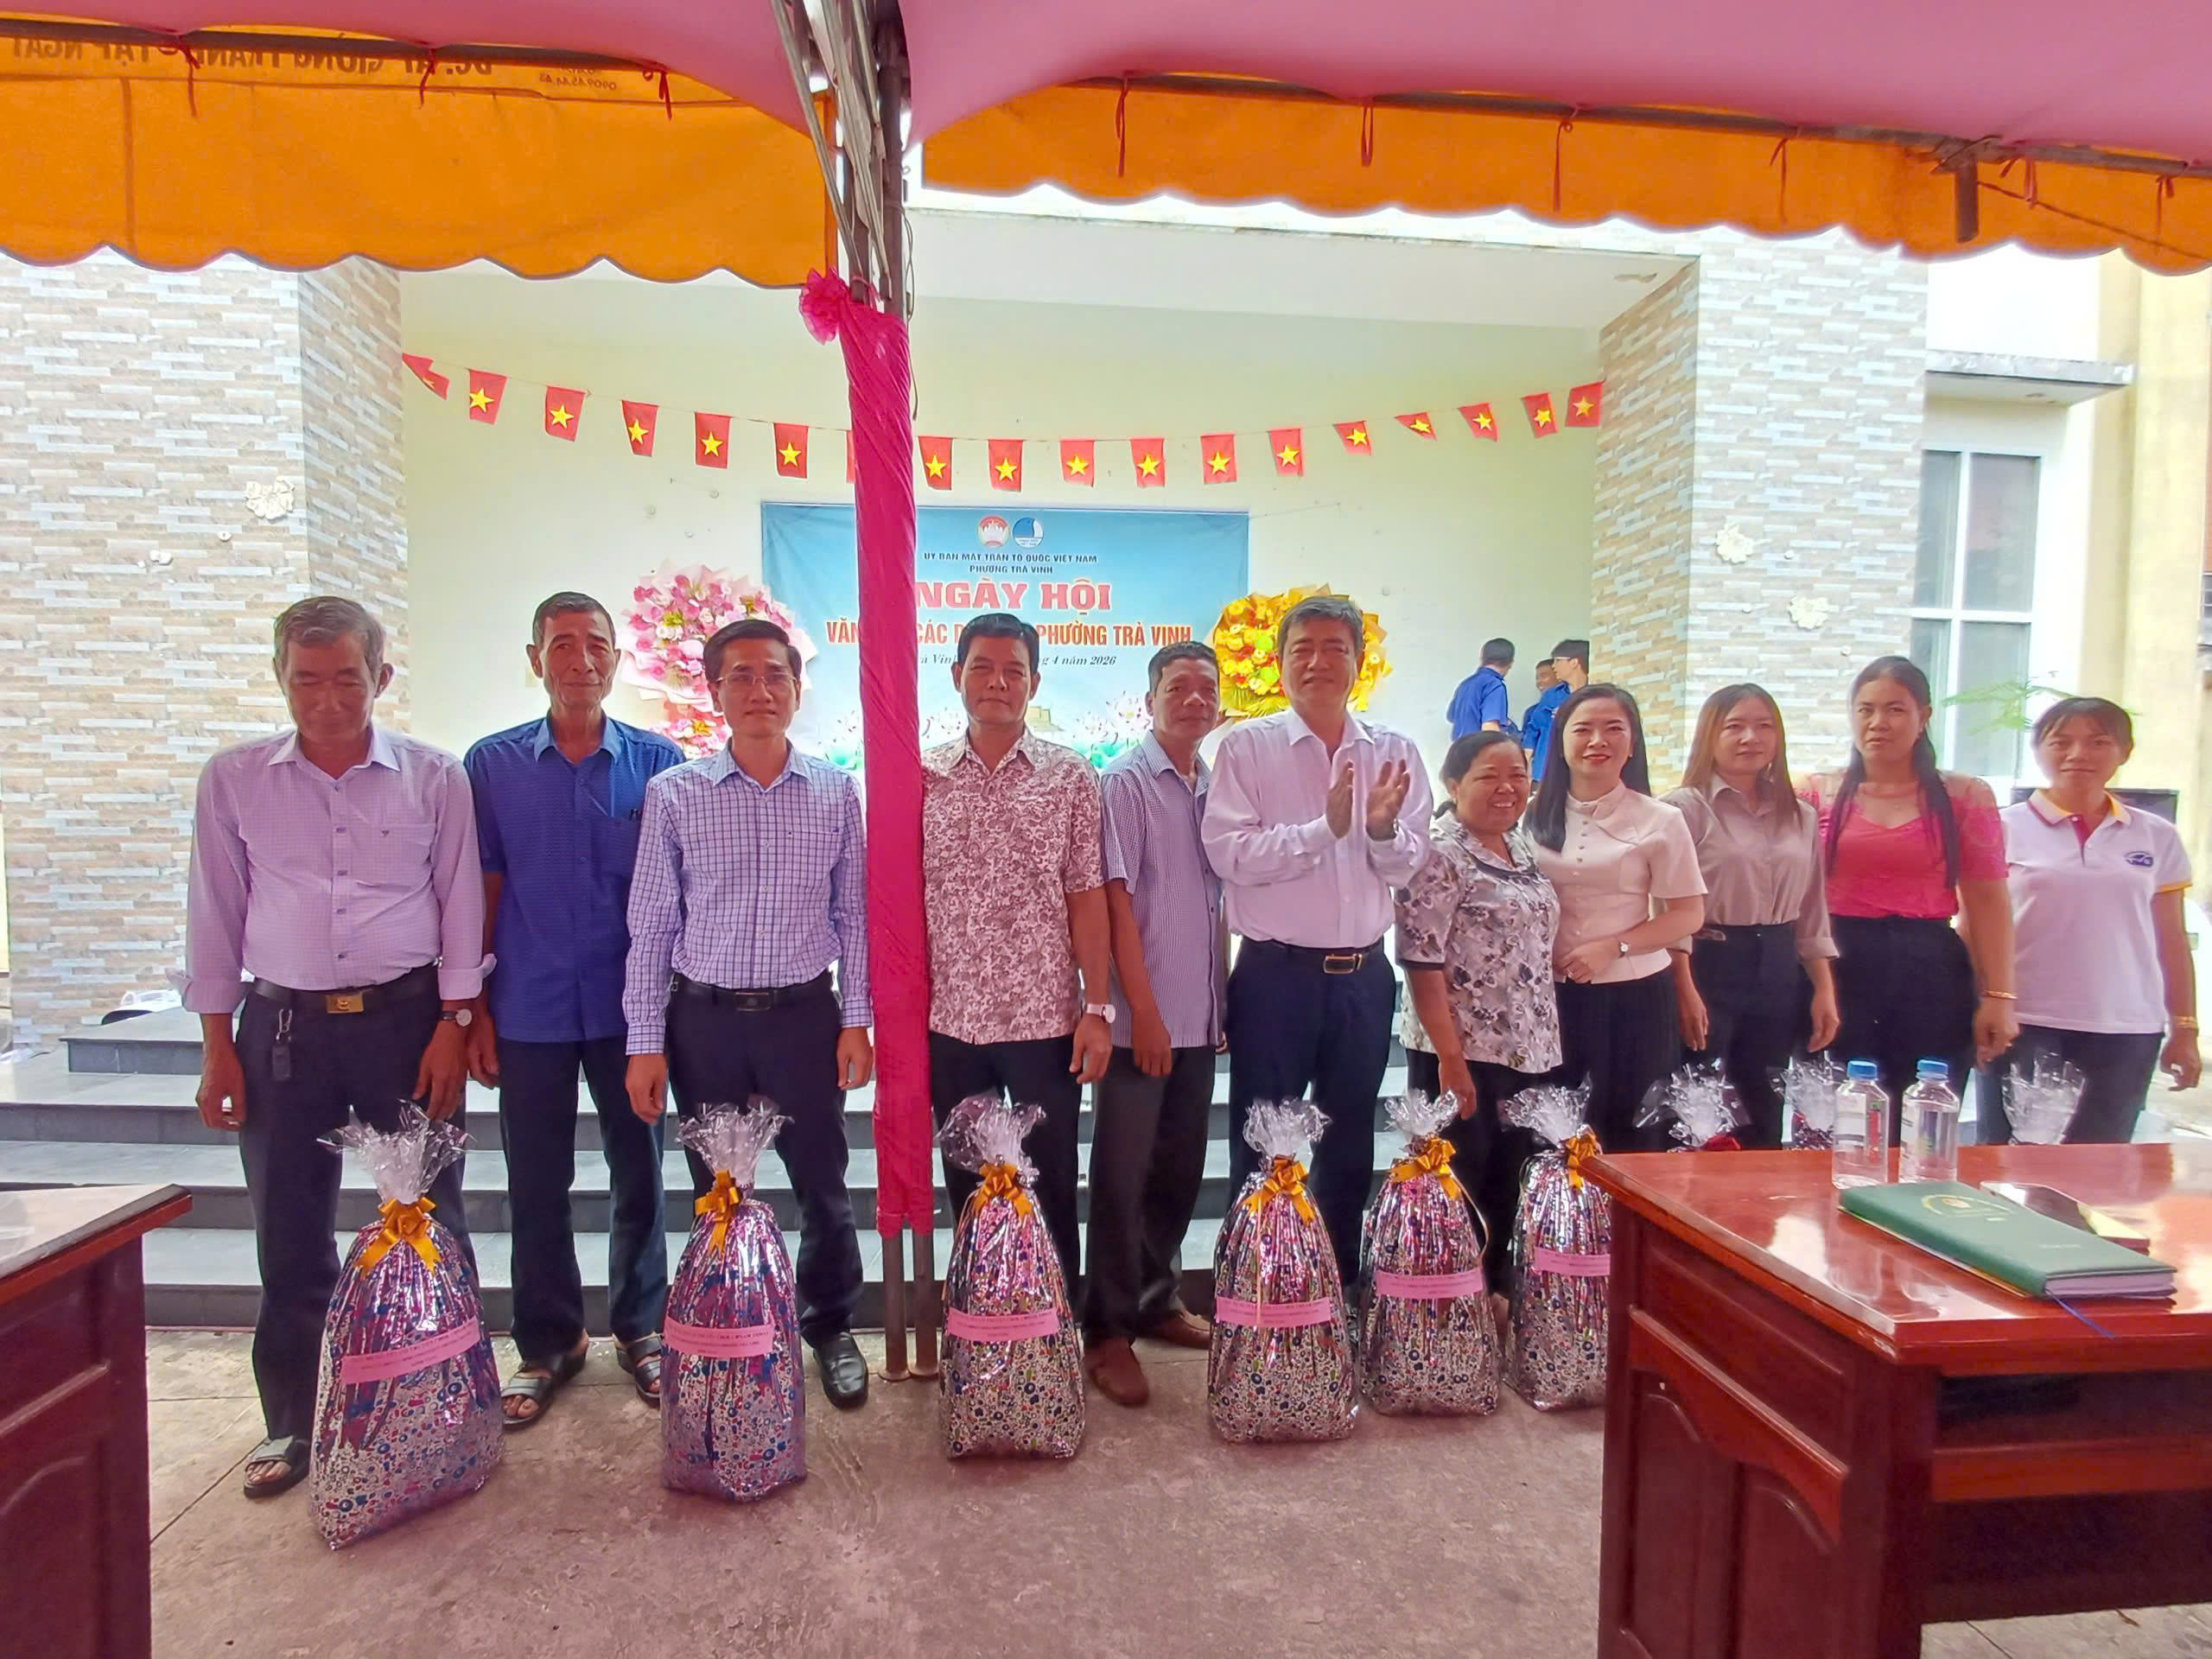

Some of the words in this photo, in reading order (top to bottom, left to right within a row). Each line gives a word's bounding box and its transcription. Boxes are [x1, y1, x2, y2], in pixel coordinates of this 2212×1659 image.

[917, 577, 1027, 608] NGÀY
[1040, 579, 1111, 615] HỘI
[826, 618, 859, 644] VĂN
[916, 620, 948, 645] CÁC
[1036, 620, 1107, 645] PHƯỜNG
[1113, 622, 1146, 646] TRÀ
[1151, 626, 1192, 646] VINH
[1090, 656, 1116, 665] 2026
